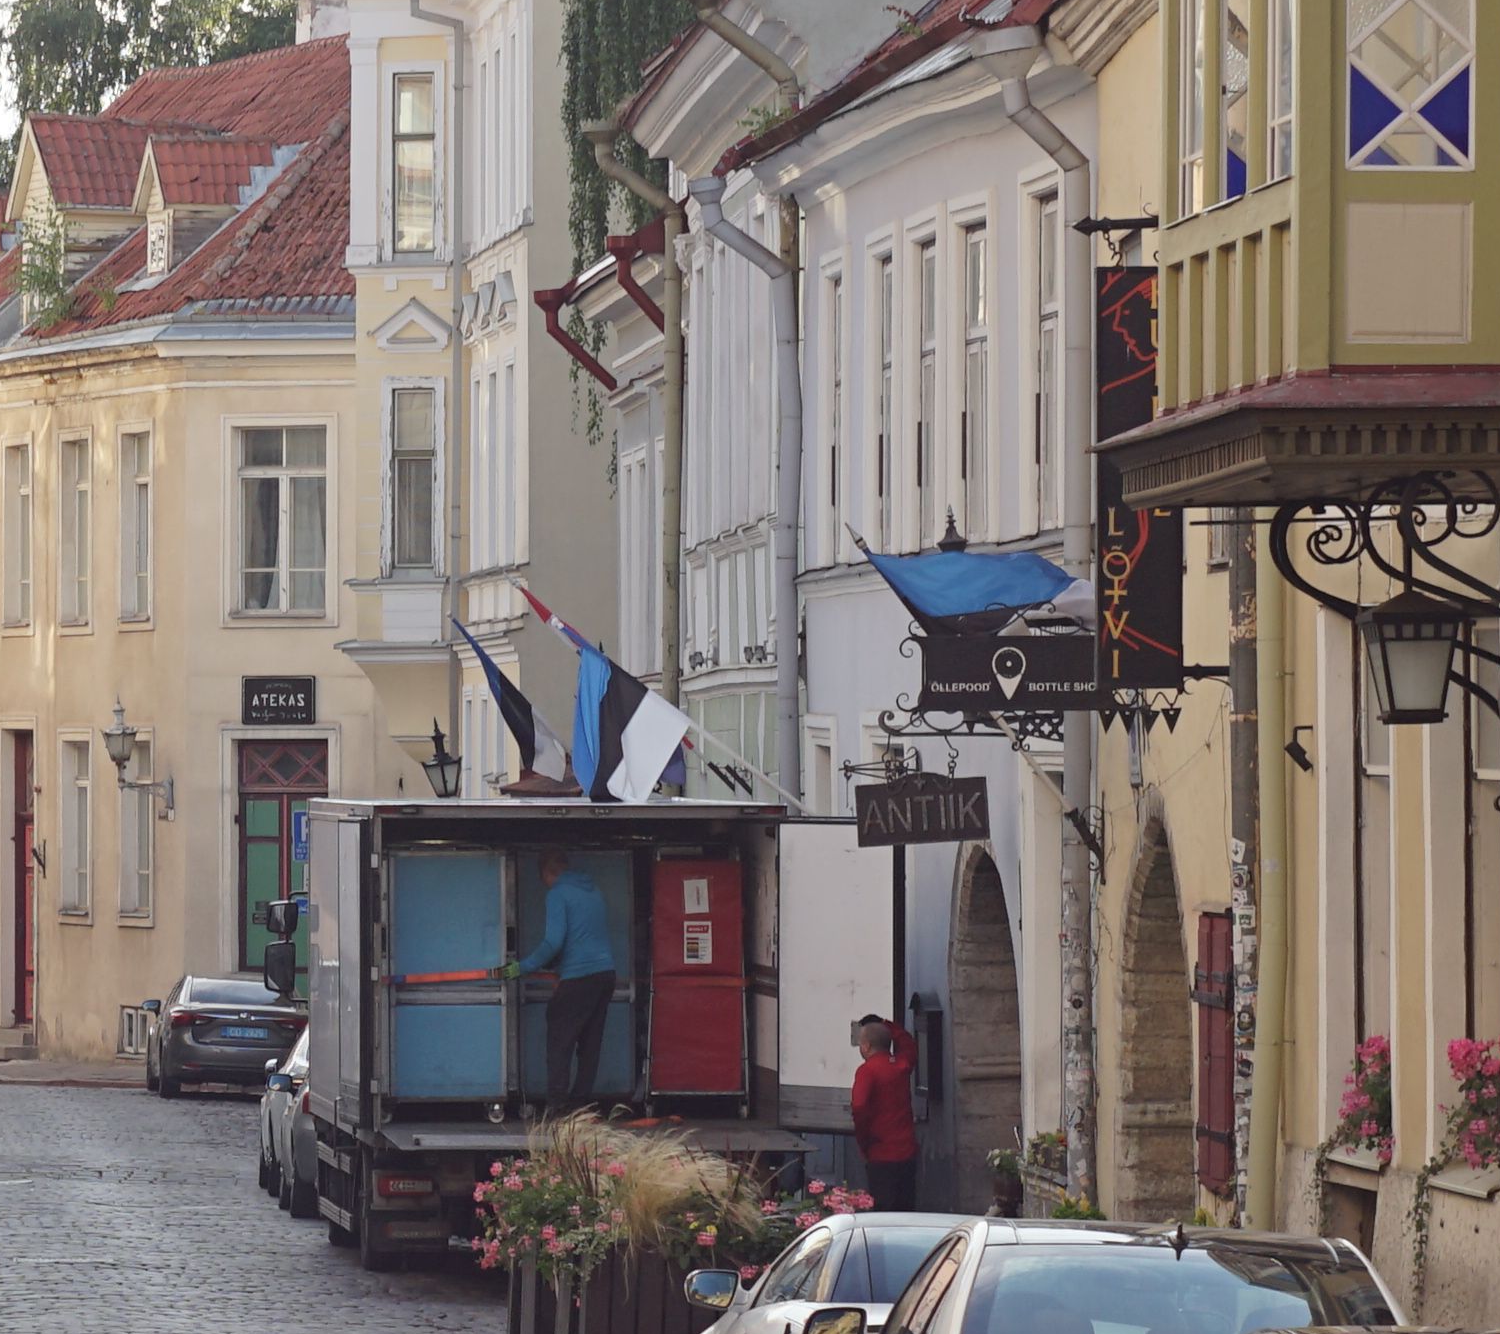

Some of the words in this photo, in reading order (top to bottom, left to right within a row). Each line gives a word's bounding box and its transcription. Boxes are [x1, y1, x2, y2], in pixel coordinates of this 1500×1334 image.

[1028, 681, 1071, 693] BOTTLE
[252, 693, 305, 707] ATEKAS
[861, 791, 984, 836] ANTIIK
